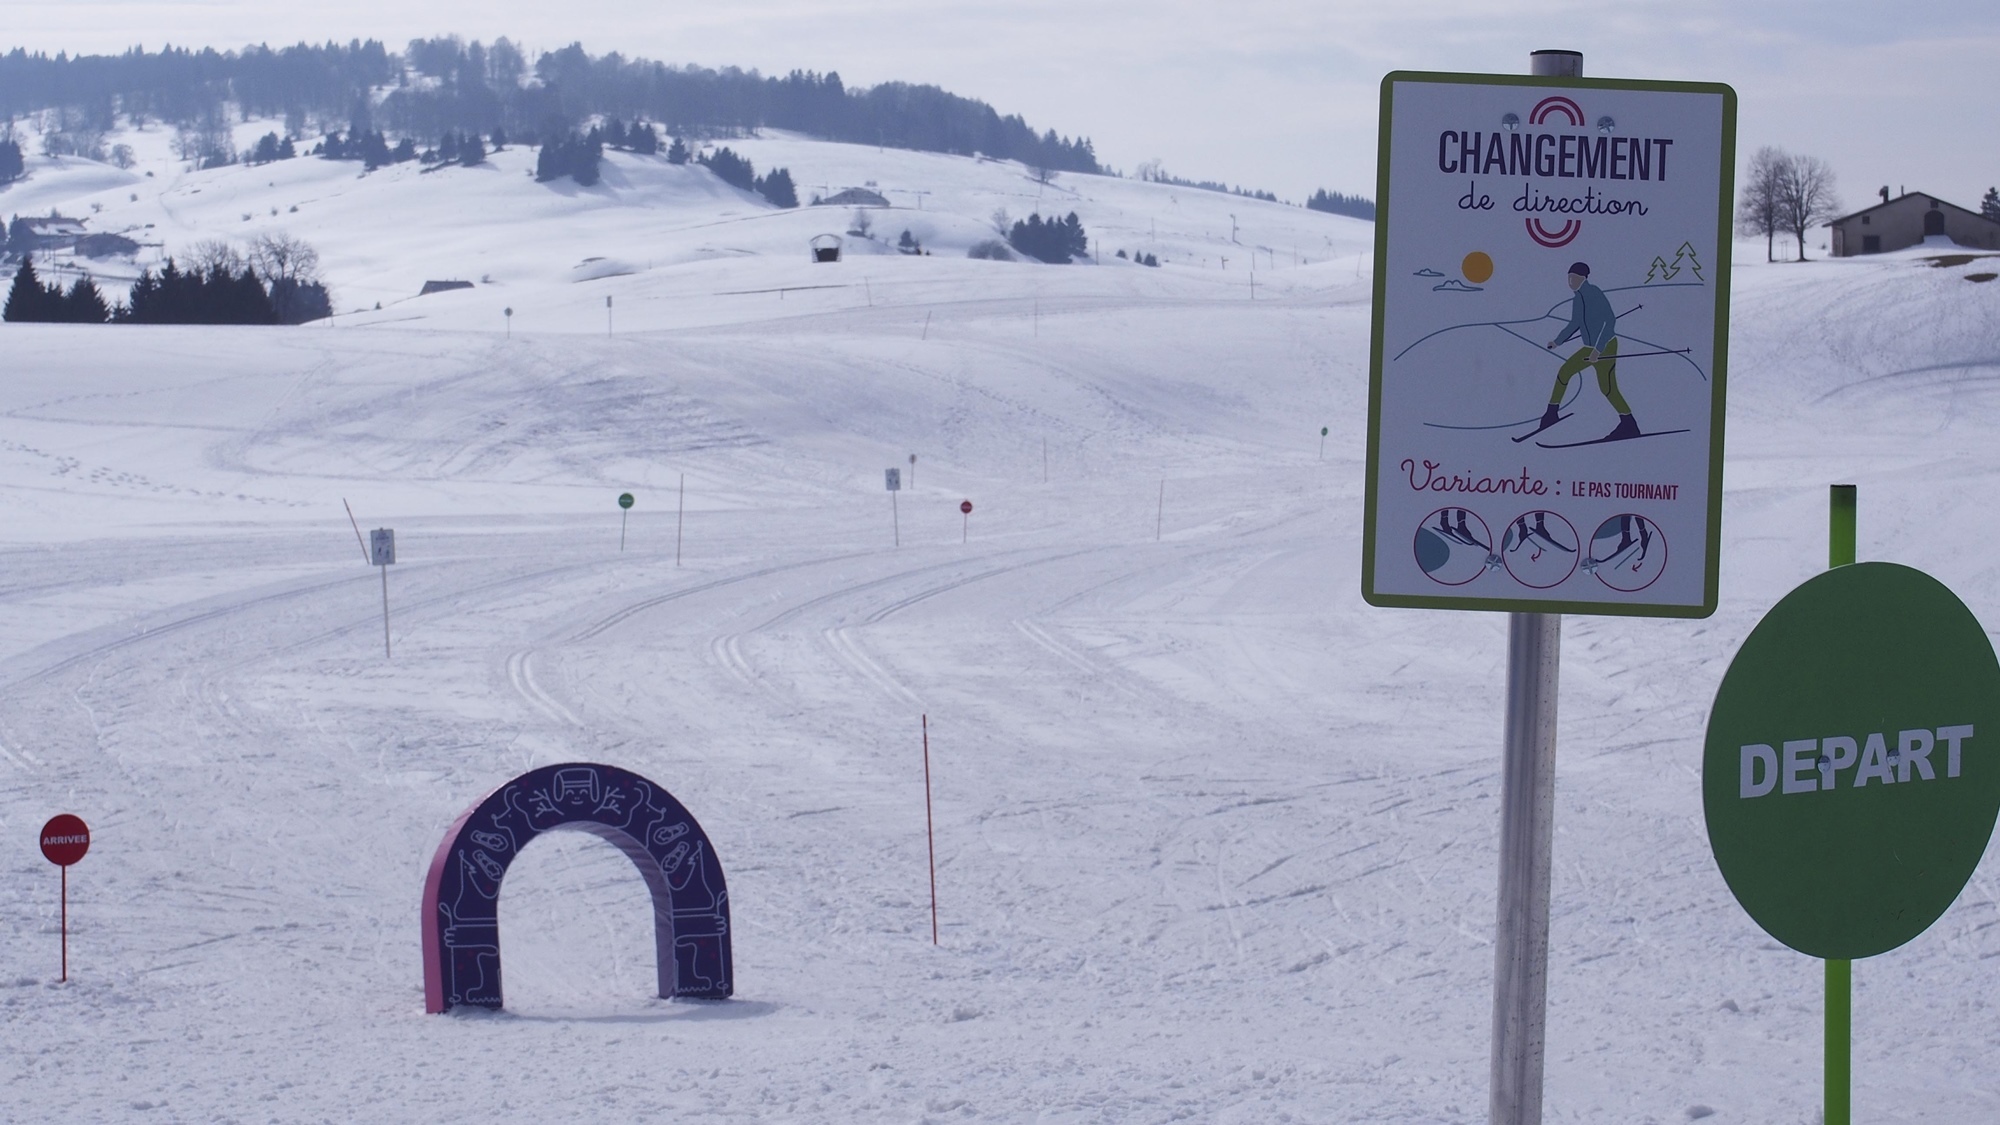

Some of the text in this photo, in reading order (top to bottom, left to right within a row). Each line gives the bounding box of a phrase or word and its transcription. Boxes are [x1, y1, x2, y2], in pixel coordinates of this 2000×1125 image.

[1438, 130, 1673, 182] CHANGEMENT
[1458, 180, 1649, 216] de direction
[1400, 458, 1548, 496] Variante
[1571, 481, 1585, 497] LE
[1588, 482, 1611, 498] PAS
[1614, 482, 1679, 501] TOURNANT
[1739, 724, 1974, 799] DEPART
[43, 834, 87, 846] ARRIVEE
